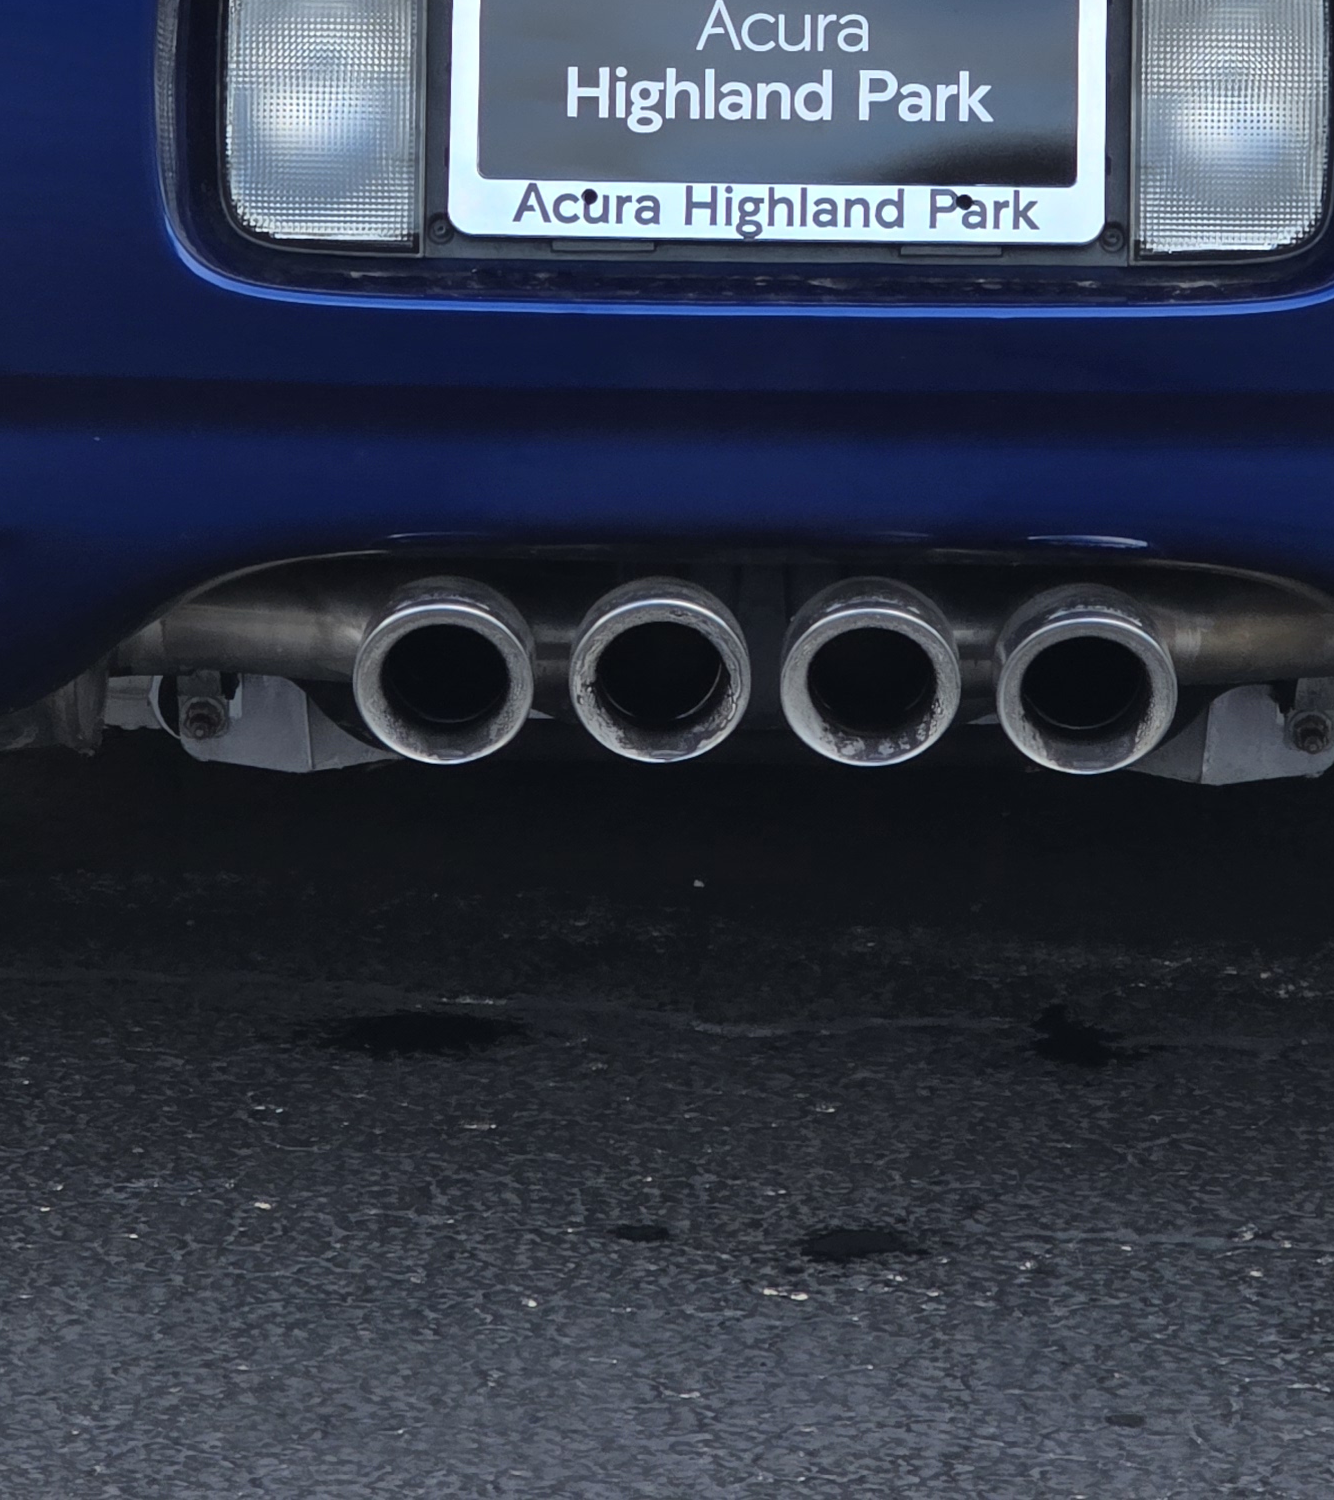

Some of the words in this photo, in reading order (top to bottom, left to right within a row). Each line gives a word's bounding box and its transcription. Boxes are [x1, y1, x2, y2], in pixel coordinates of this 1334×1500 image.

[696, 0, 870, 51] Acura
[566, 66, 833, 133] Highland
[858, 70, 994, 123] Park
[512, 182, 661, 225] Acura
[684, 185, 905, 238] Highland
[929, 188, 1040, 230] Park
